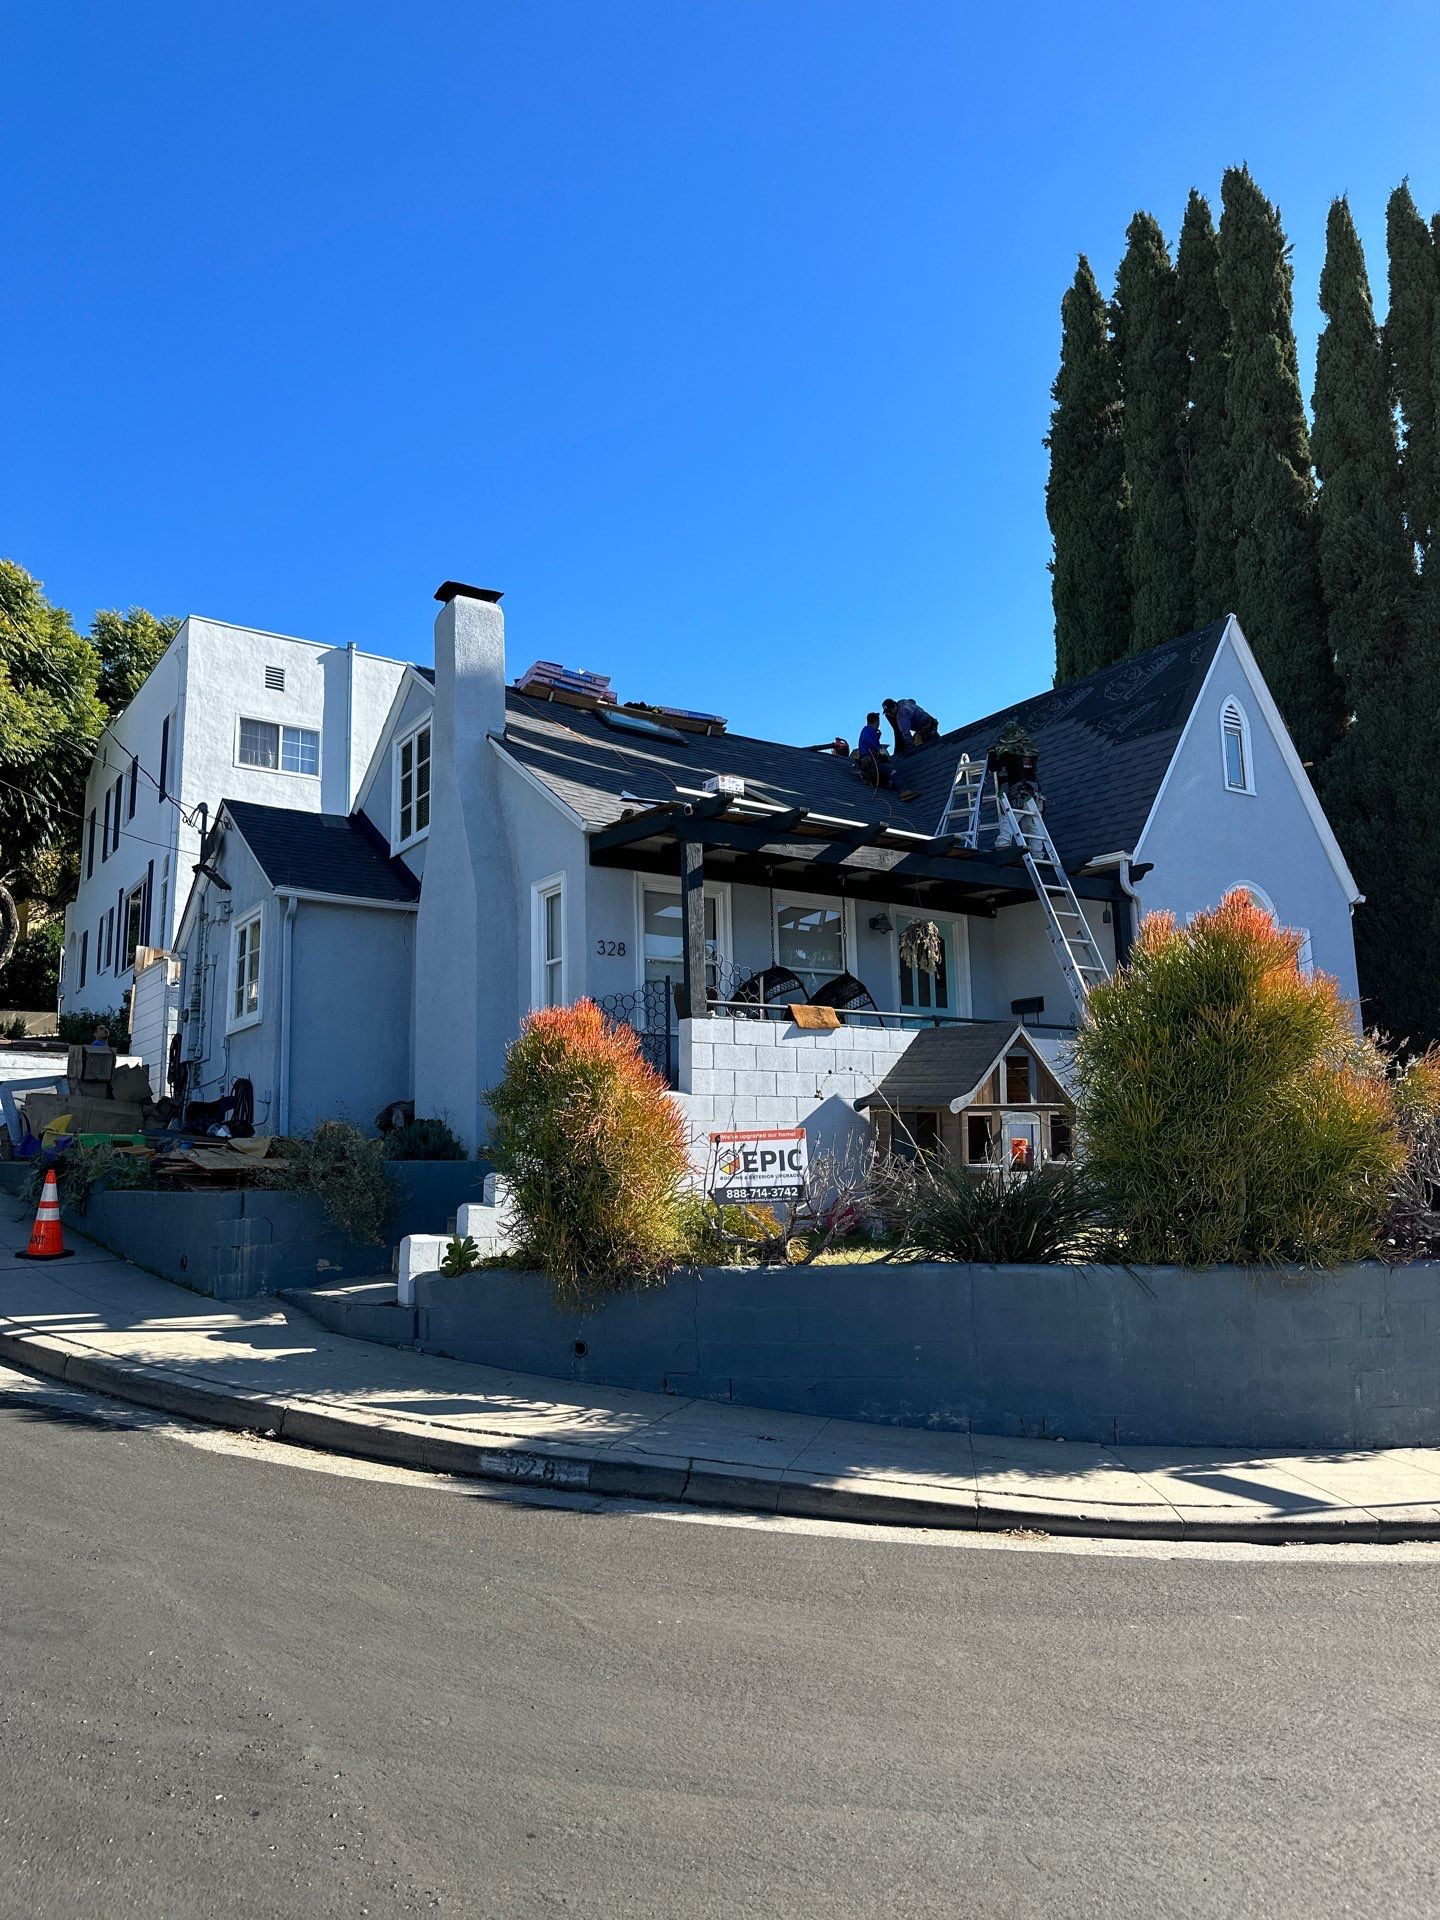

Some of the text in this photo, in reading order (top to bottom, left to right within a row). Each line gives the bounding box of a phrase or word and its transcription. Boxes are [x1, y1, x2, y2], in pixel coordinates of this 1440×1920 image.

[597, 940, 626, 956] 328
[742, 1149, 803, 1173] EPIC
[726, 1187, 799, 1199] 888-714-3742
